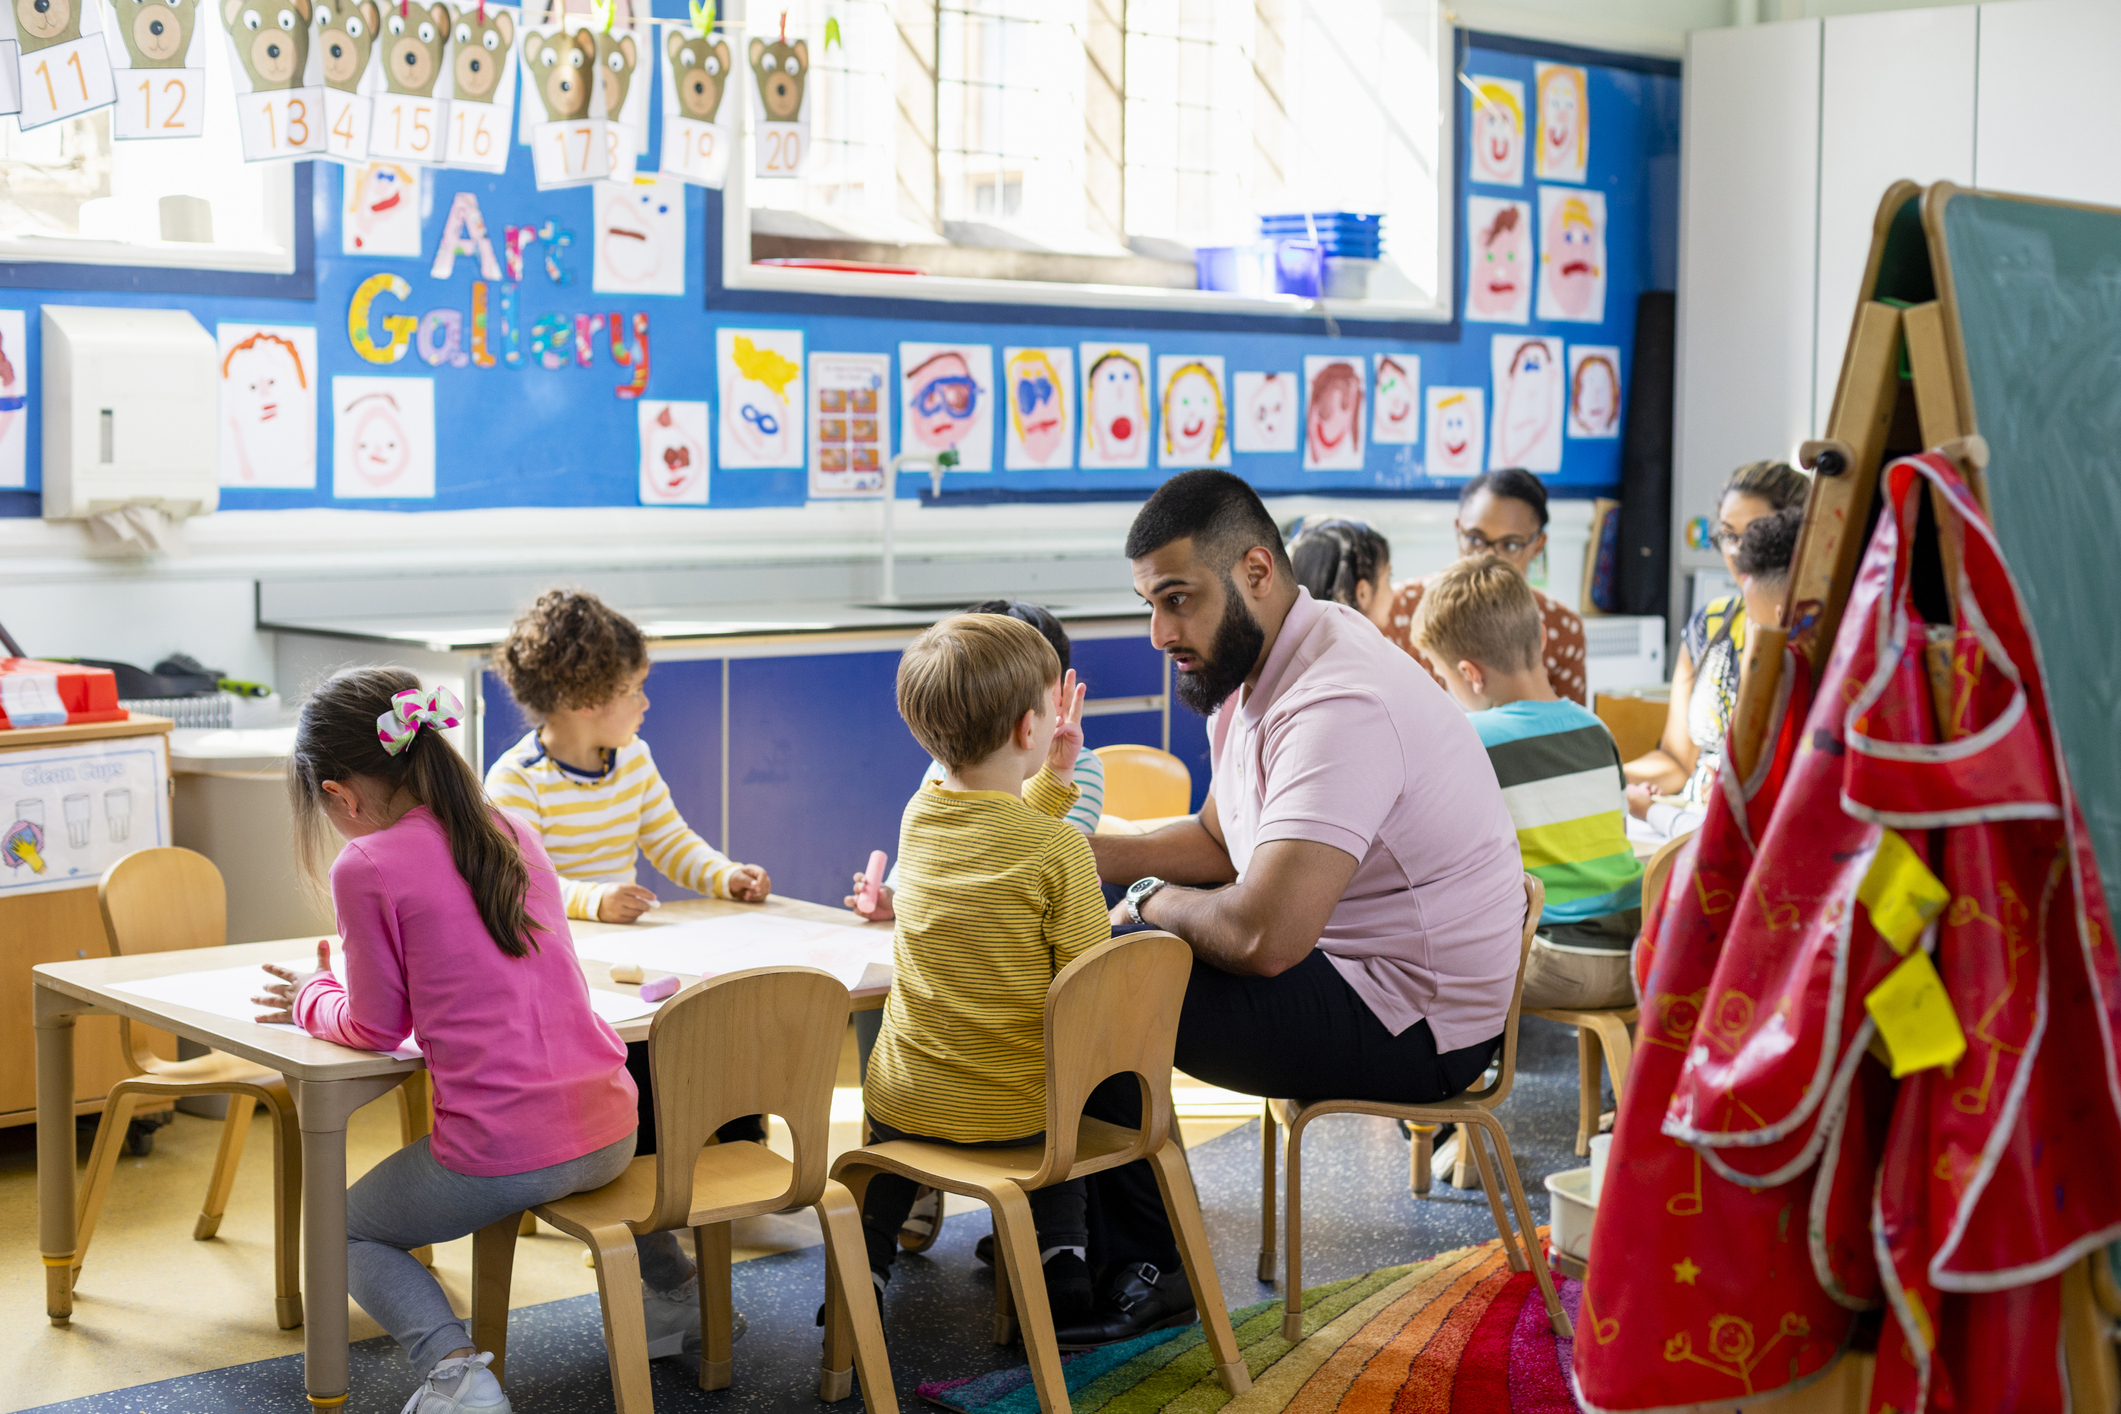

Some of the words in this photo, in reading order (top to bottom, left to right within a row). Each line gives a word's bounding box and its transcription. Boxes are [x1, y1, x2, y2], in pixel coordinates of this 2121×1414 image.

[35, 50, 88, 110] 11
[138, 78, 186, 129] 12
[262, 99, 309, 149] 13
[392, 104, 431, 151] 15
[456, 111, 491, 156] 16
[555, 128, 592, 174] 17
[682, 128, 715, 171] 19
[766, 130, 800, 171] 20
[430, 191, 575, 286] Art
[348, 273, 649, 399] Gallery
[22, 764, 77, 787] Clean
[79, 760, 125, 782] Cups
